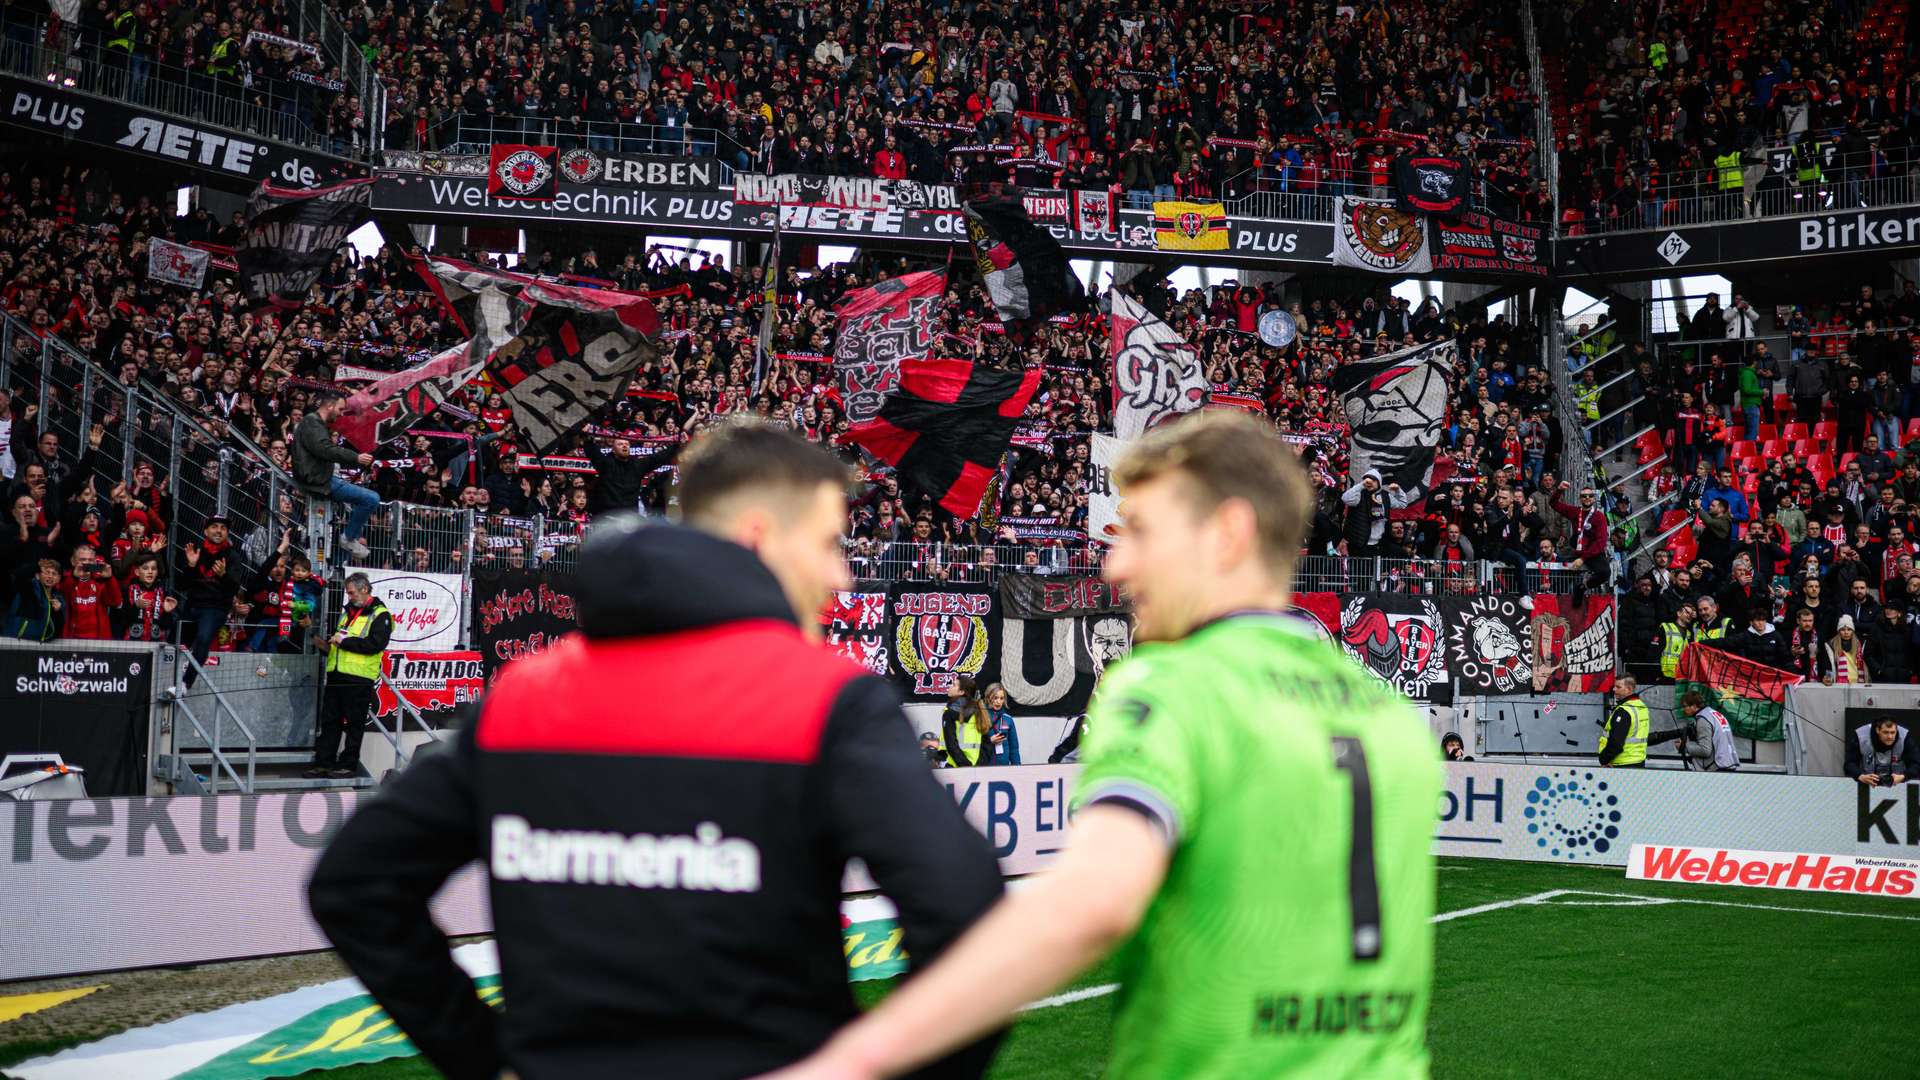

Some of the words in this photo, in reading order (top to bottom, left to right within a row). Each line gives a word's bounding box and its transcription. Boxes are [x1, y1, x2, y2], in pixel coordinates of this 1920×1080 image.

[11, 92, 85, 130] PLUS
[603, 157, 711, 187] ERBEN
[666, 198, 733, 221] PLUS
[1236, 230, 1298, 252] PLUS
[388, 589, 404, 600] Fan
[405, 589, 427, 600] Club
[894, 592, 991, 616] JUGEND
[1450, 596, 1515, 687] COMMANDO
[1565, 605, 1615, 655] FREIHEIT
[38, 658, 84, 673] Made
[90, 659, 109, 673] im
[928, 656, 950, 671] 04
[1401, 660, 1419, 673] 04
[1568, 652, 1614, 674] ULTRAS
[16, 677, 128, 693] Schwrzwald
[391, 680, 446, 690] EVERKUSEN
[491, 814, 762, 893] Barmenia
[1331, 736, 1382, 960] 1
[1642, 847, 1918, 896] WeberHaus
